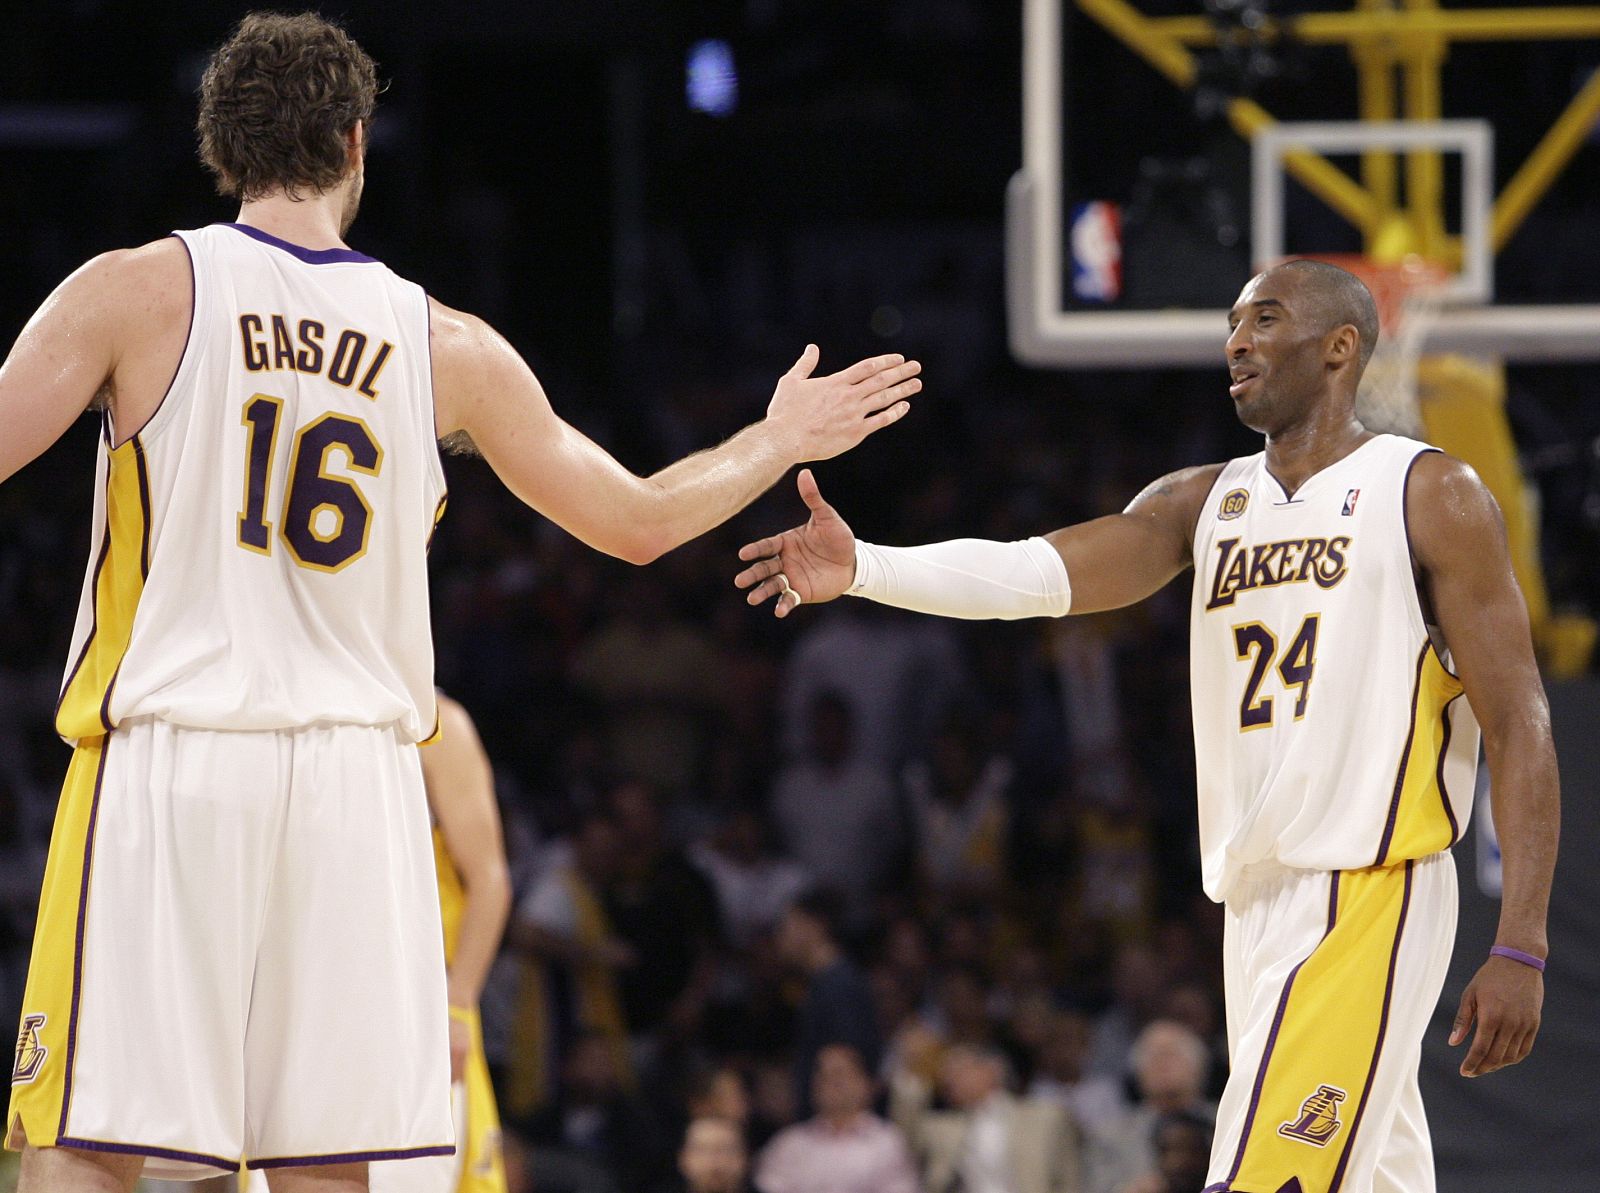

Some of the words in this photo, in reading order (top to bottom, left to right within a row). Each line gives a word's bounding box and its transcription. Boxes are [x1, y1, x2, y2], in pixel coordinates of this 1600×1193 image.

[238, 313, 395, 402] GASOL
[236, 392, 385, 575] 16
[1225, 496, 1245, 513] 60
[1205, 536, 1354, 612] LAKERS
[1231, 612, 1322, 733] 24
